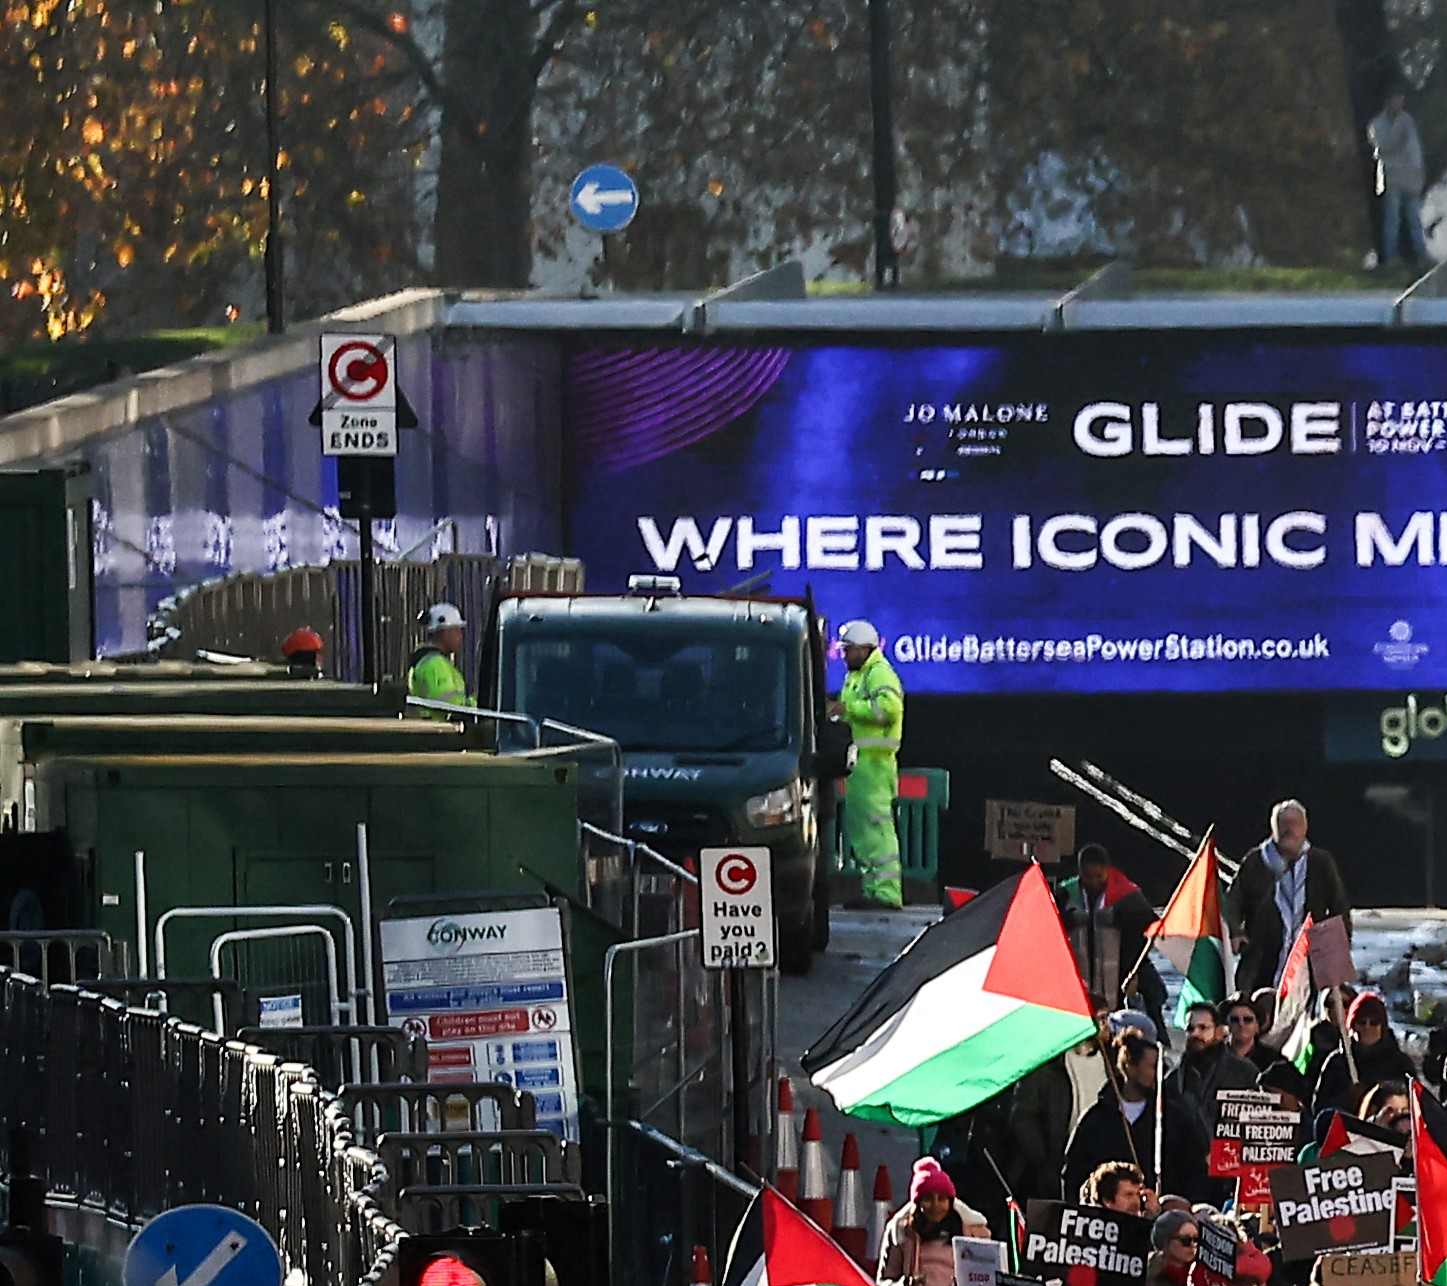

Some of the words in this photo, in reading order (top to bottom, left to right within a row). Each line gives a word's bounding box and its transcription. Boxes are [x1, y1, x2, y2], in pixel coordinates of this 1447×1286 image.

[341, 415, 377, 428] Zone
[944, 404, 1049, 422] MALONE
[1074, 401, 1340, 456] GLIDE
[331, 432, 388, 448] ENDS
[636, 512, 984, 571] WHERE
[1012, 510, 1327, 570] ICONIC
[895, 634, 1330, 663] GlideBatterseaPowerStation.co.uk
[713, 902, 762, 918] Have
[720, 923, 755, 939] you
[711, 942, 767, 960] paid?
[1245, 1125, 1294, 1140] FREEDOM
[1242, 1146, 1295, 1163] PALESTINE
[1305, 1164, 1363, 1194] Free
[1278, 1185, 1395, 1227] Palestine
[1060, 1208, 1119, 1241] Free
[1026, 1233, 1144, 1278] Palestine
[1331, 1256, 1414, 1277] CEASEF
